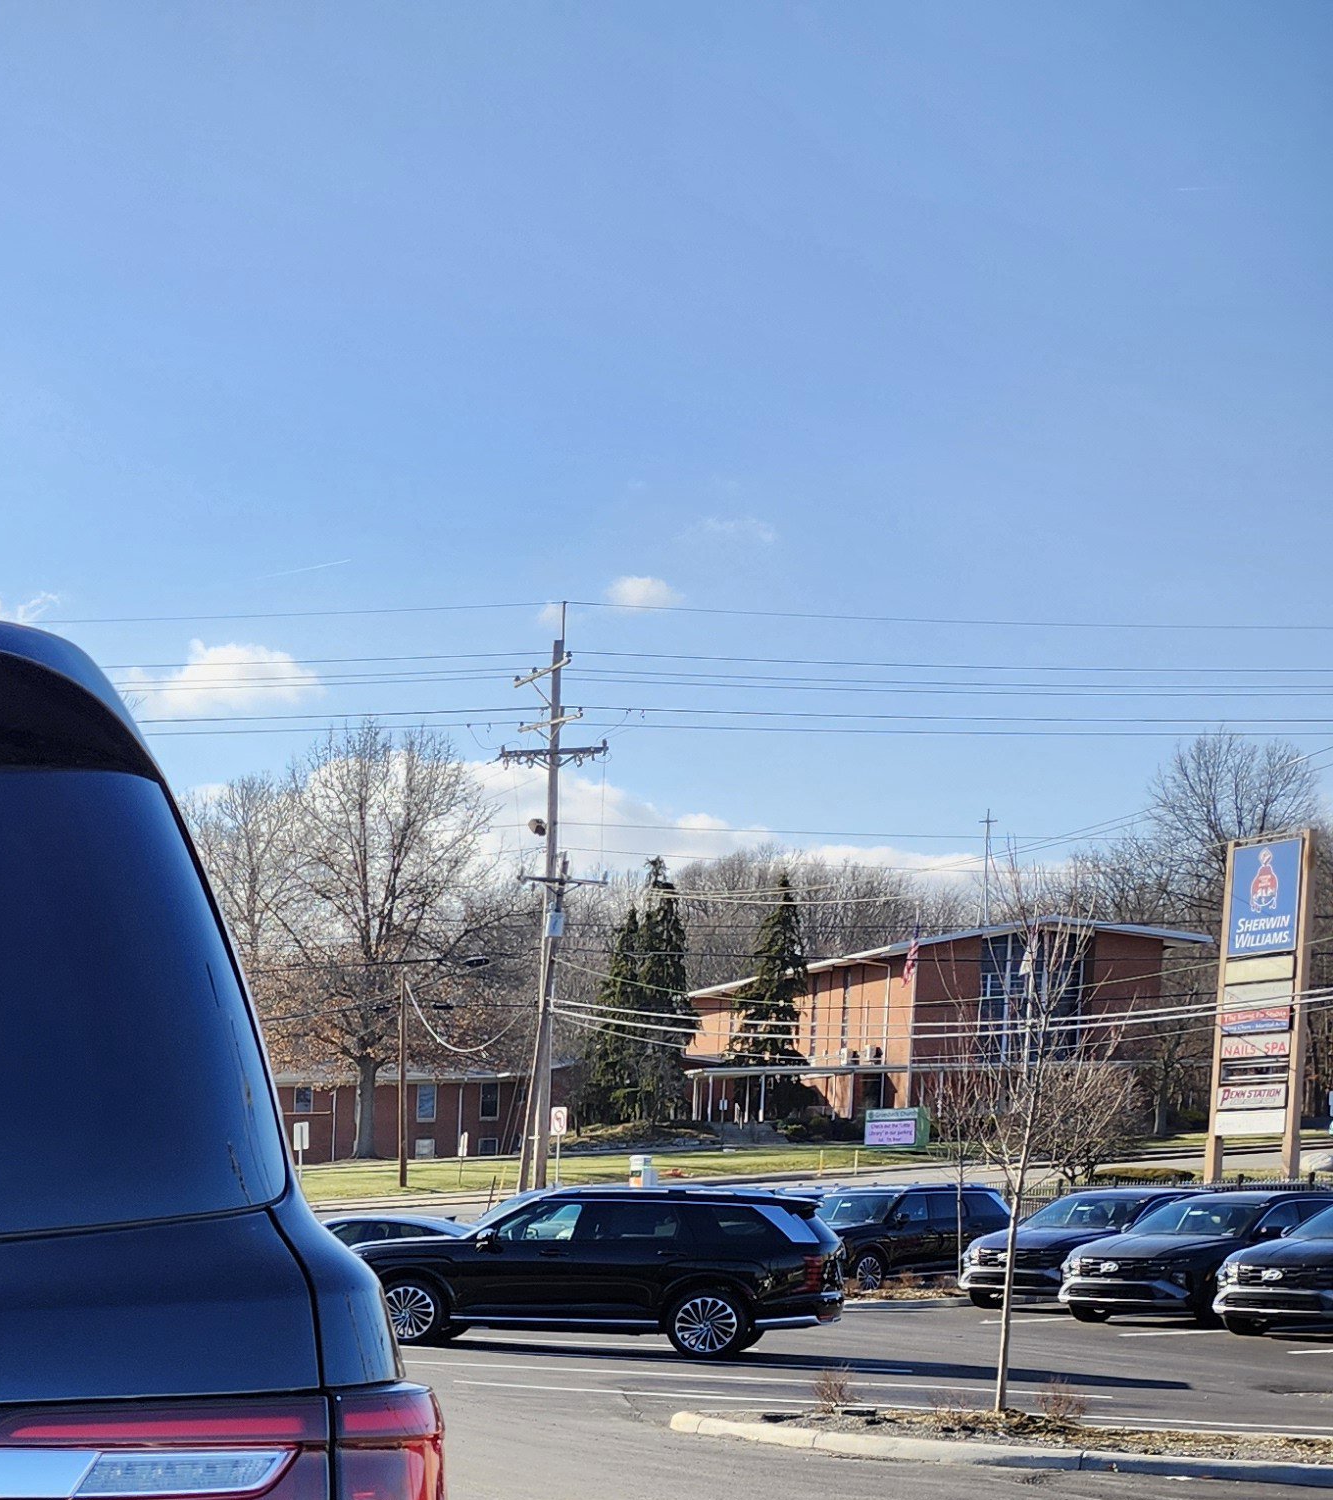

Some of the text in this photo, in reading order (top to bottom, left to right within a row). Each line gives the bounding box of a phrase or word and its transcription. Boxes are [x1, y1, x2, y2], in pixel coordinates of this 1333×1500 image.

[1236, 915, 1290, 933] SHERWIN
[1235, 931, 1289, 949] WILLIAMS
[1224, 1041, 1286, 1056] NAILS SPA
[1220, 1087, 1246, 1107] PENN
[1246, 1088, 1282, 1098] STATION
